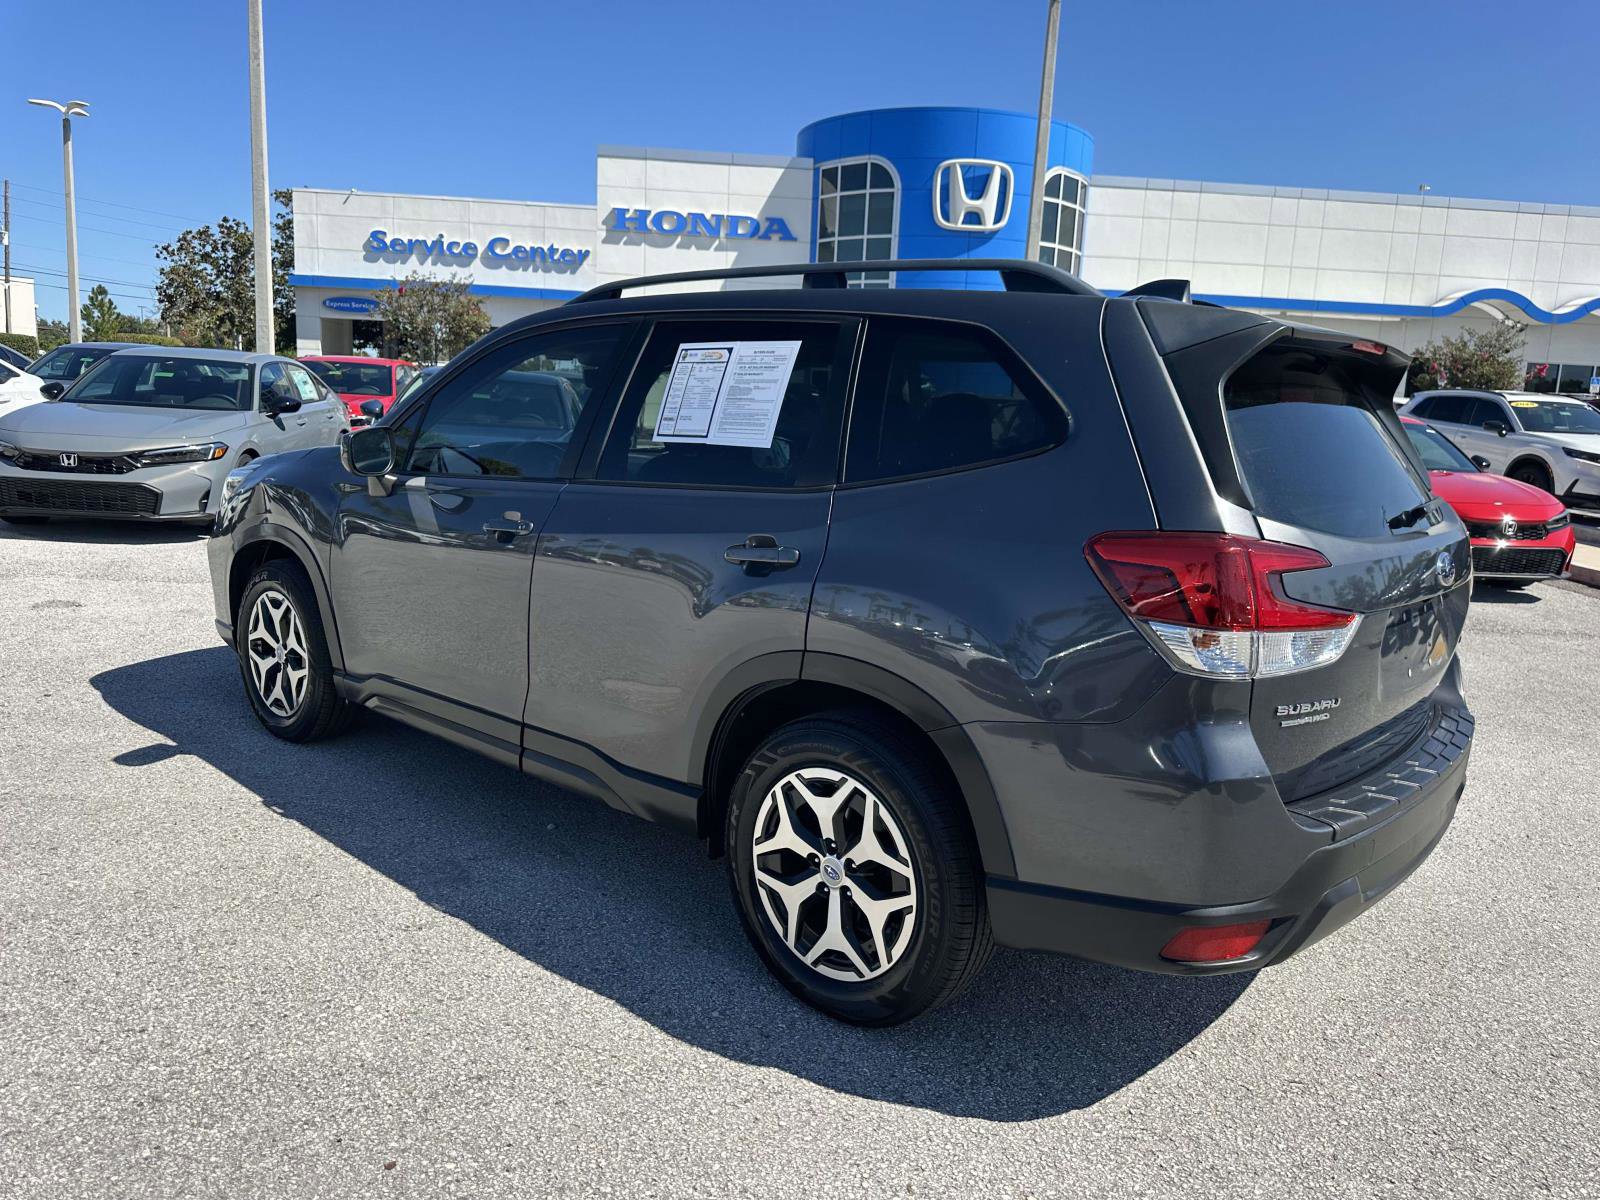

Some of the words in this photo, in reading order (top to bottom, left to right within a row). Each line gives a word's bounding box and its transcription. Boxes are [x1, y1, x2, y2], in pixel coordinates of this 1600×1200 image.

[612, 207, 797, 242] HONDA
[369, 229, 478, 257] Service
[487, 237, 590, 265] Center
[326, 300, 350, 308] Express
[1276, 698, 1341, 716] SUBARU
